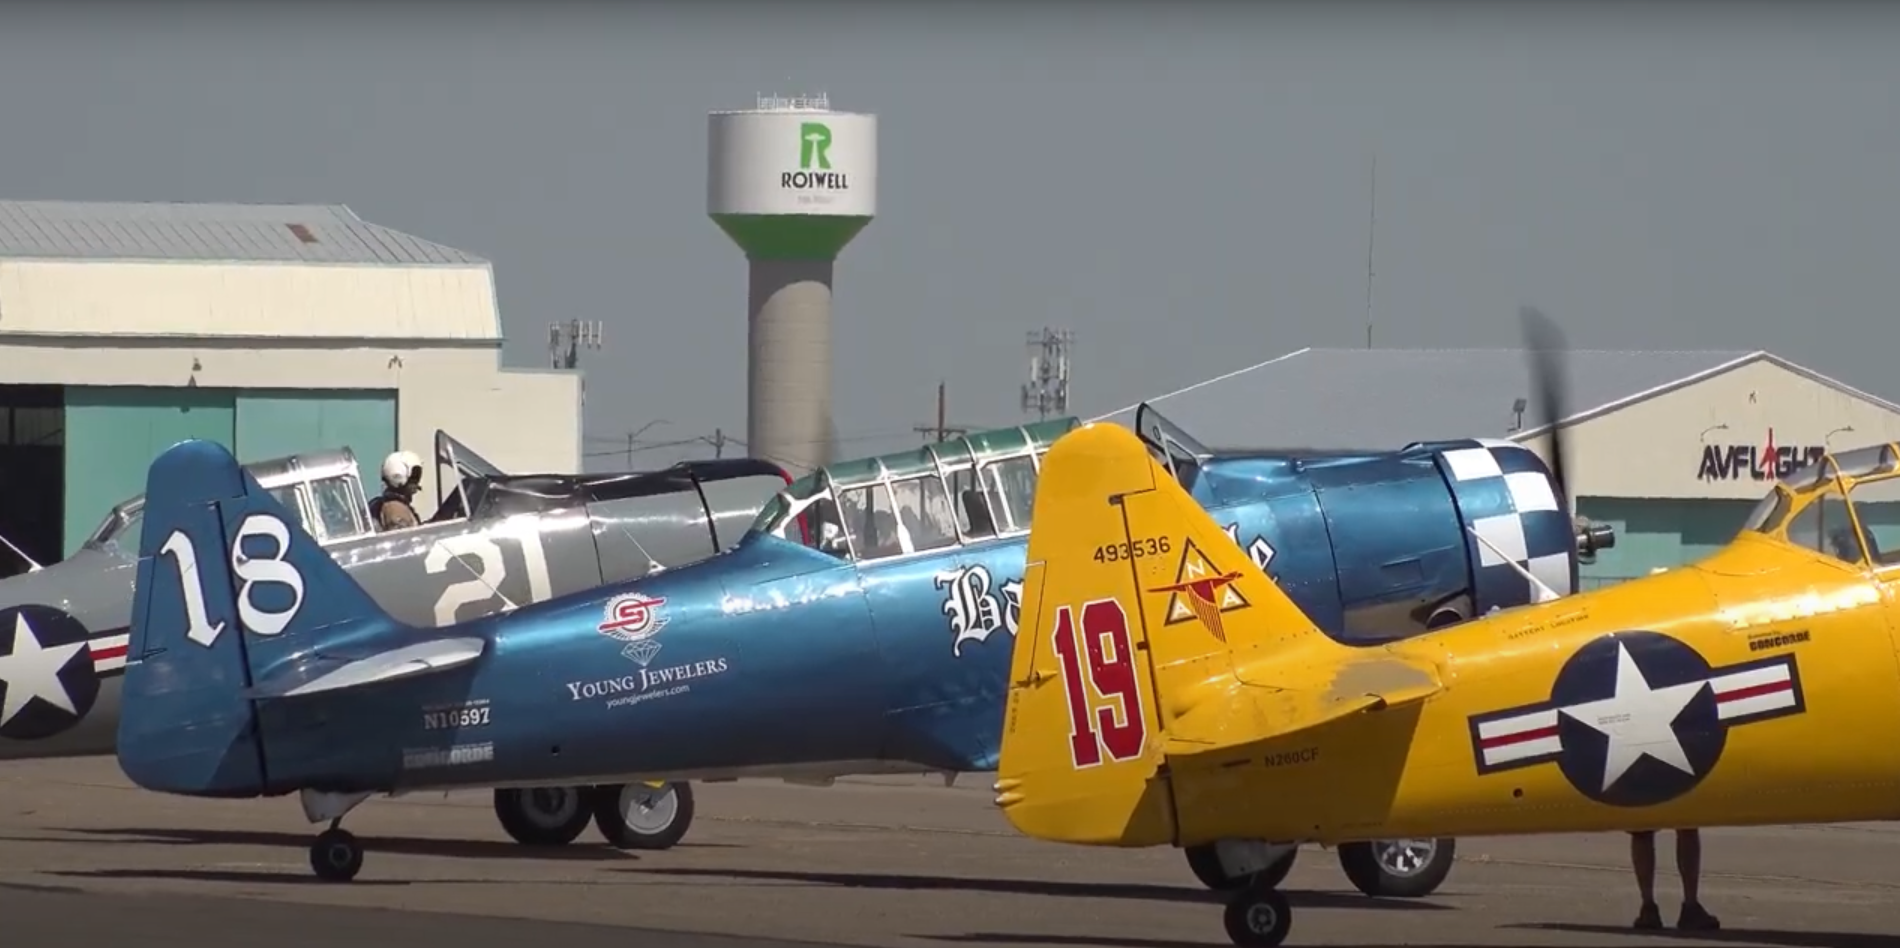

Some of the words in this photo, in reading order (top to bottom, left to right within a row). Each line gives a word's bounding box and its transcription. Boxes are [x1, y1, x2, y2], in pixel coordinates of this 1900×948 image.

[1093, 536, 1171, 564] 493536
[159, 514, 305, 648] 18
[423, 526, 552, 628] 21
[1748, 630, 1811, 652] CONCORDE
[605, 684, 691, 710] youngjewelers.com
[1051, 597, 1147, 770] 19
[423, 707, 490, 730] N10597
[1264, 745, 1320, 769] N260CF
